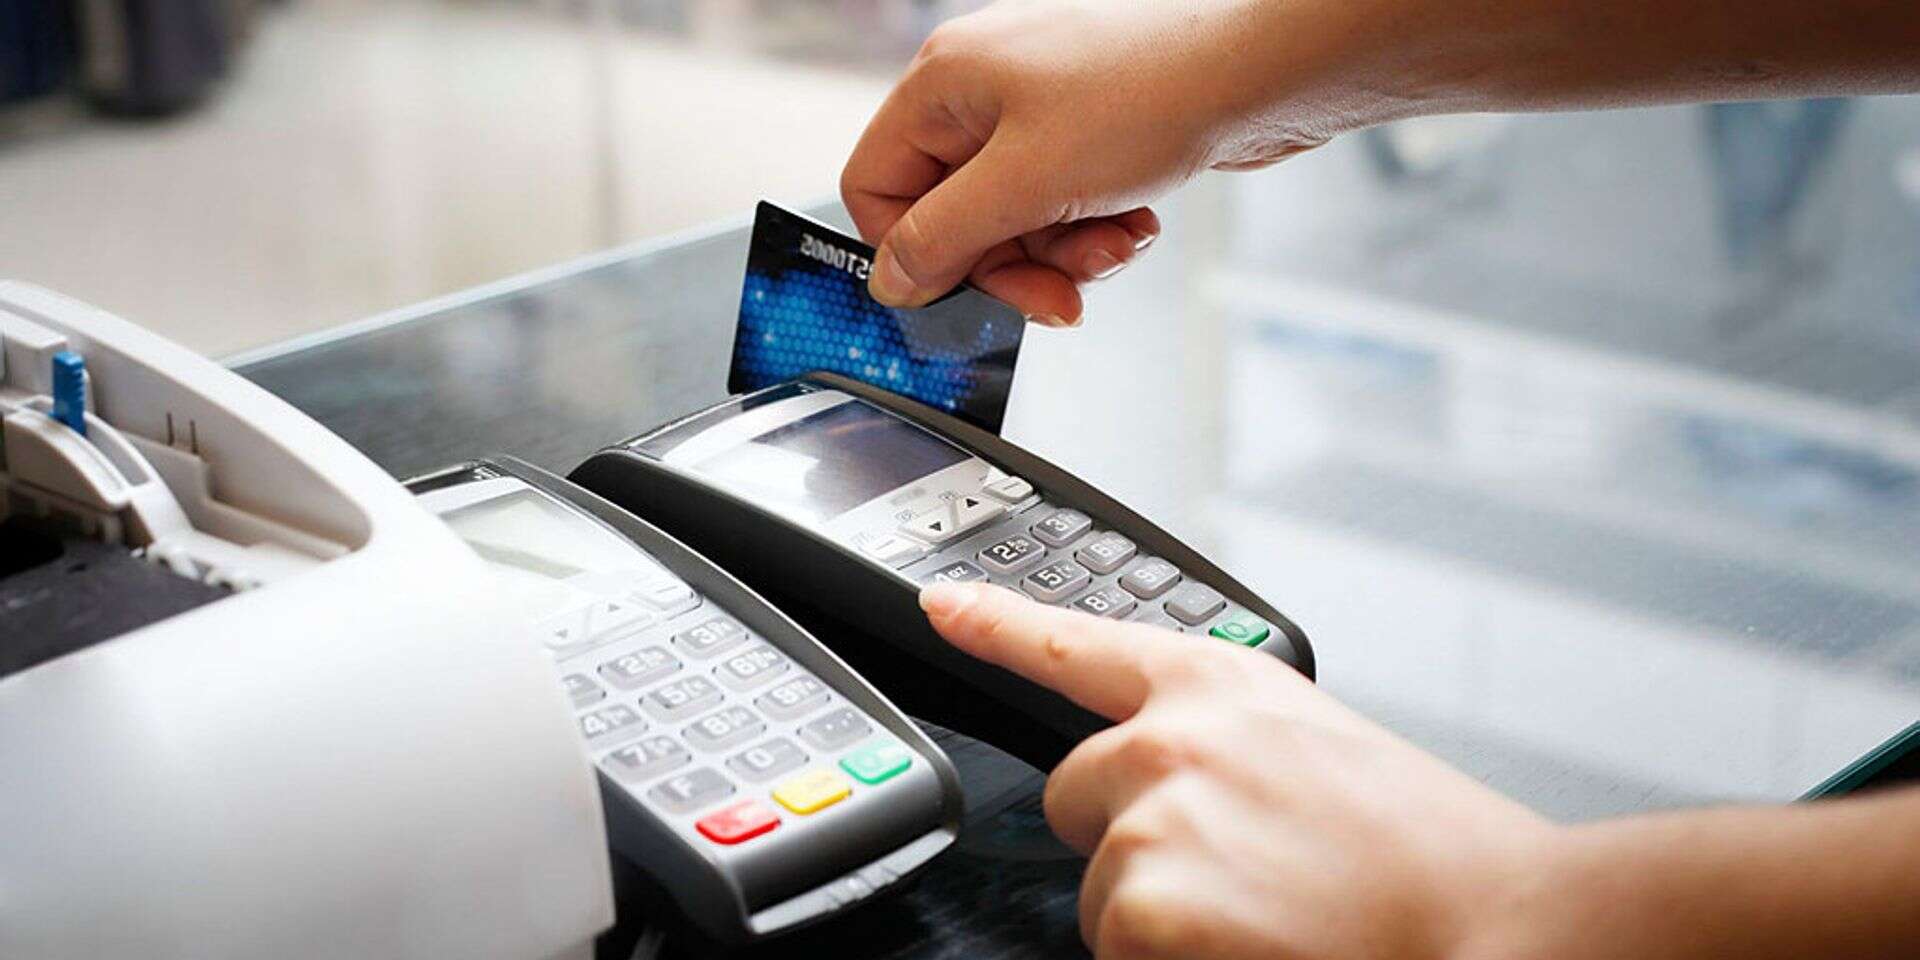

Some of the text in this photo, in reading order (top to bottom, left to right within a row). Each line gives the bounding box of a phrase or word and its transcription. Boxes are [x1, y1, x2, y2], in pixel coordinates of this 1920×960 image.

[1045, 518, 1069, 532] 3
[992, 545, 1018, 560] 2
[1037, 570, 1062, 586] 5
[1084, 596, 1109, 611] 8
[690, 626, 717, 644] 3
[618, 654, 646, 675] 2
[659, 687, 686, 705] 5
[702, 716, 731, 735] 8
[622, 745, 648, 764] 7
[746, 748, 774, 768] 0
